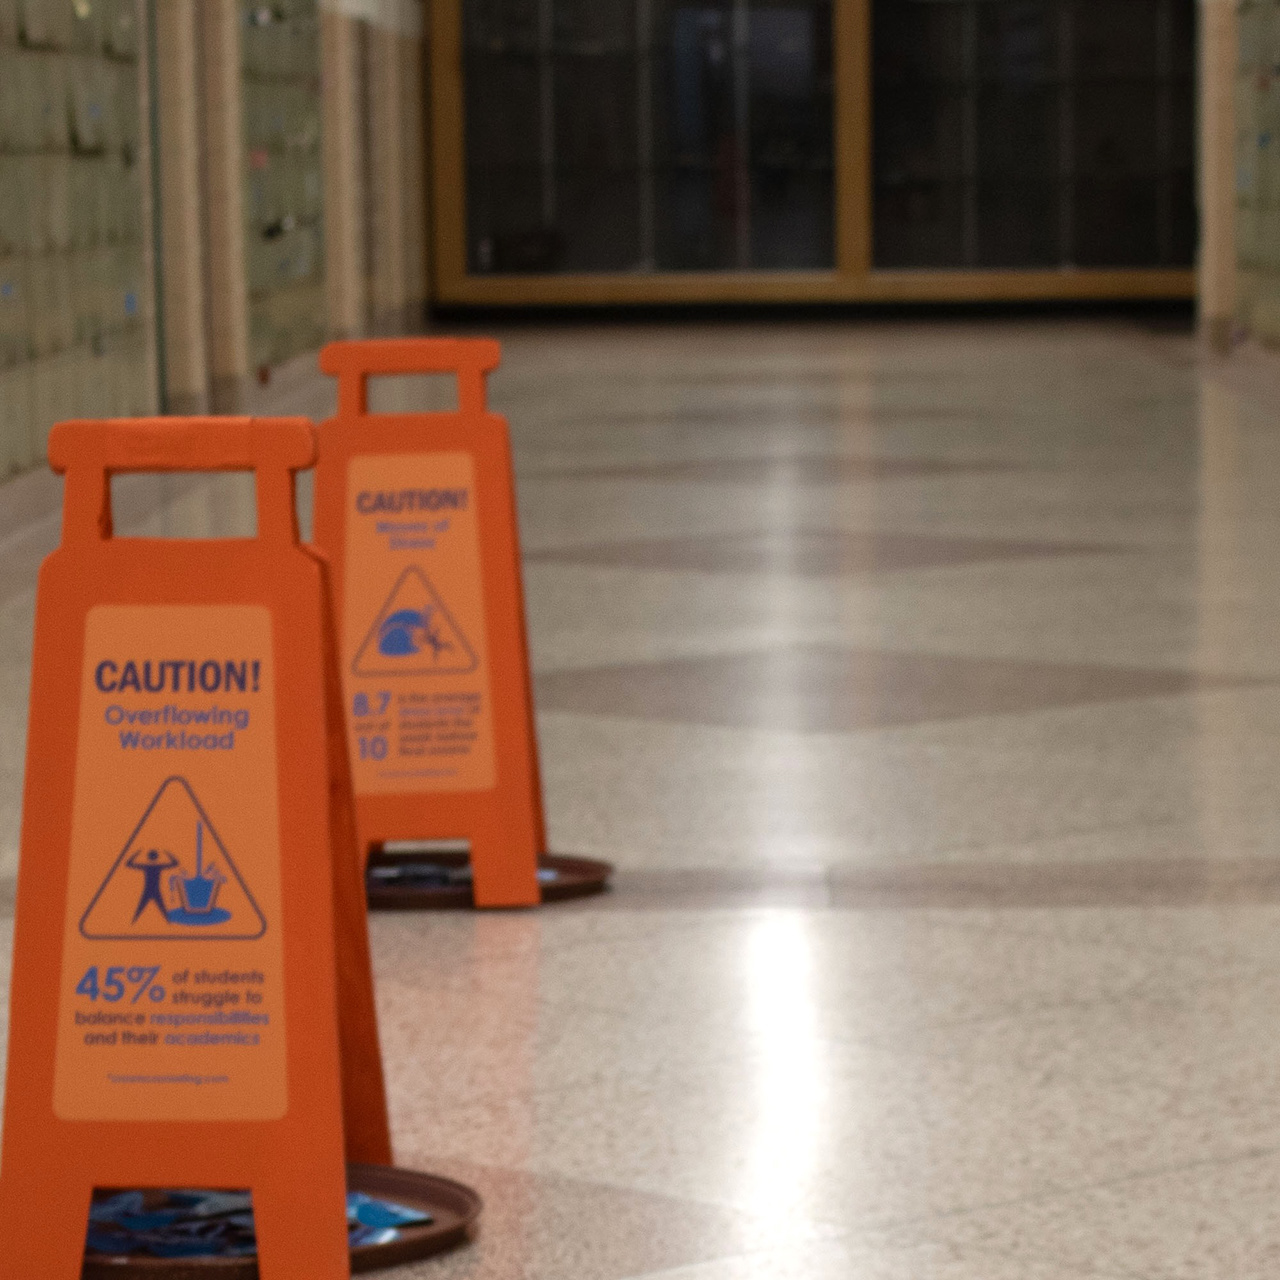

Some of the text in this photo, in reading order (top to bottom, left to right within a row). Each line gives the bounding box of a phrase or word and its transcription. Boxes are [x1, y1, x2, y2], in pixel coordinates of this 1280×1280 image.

[356, 488, 468, 515] CAUTION!
[94, 659, 261, 693] CAUTION!
[104, 704, 250, 730] Overflowing
[119, 730, 235, 750] Workload
[358, 736, 388, 761] 10
[75, 965, 166, 1004] 45%
[172, 968, 264, 985] of students
[172, 990, 263, 1008] struggle to
[83, 1031, 118, 1046] and
